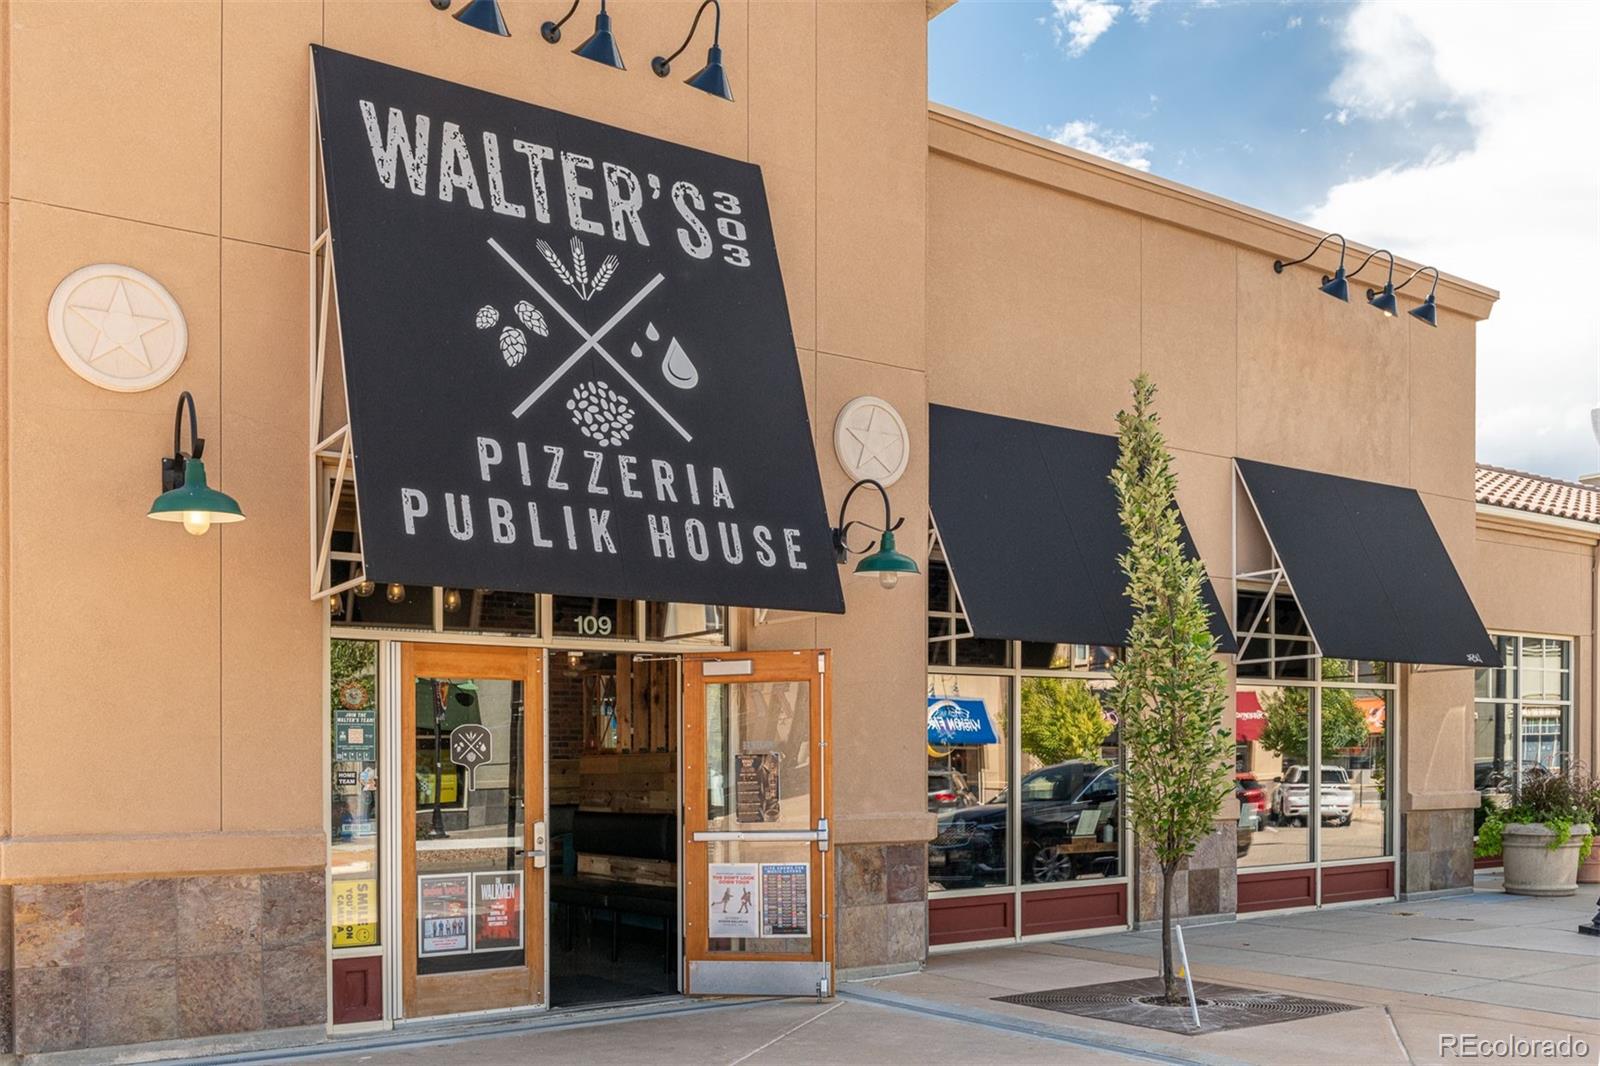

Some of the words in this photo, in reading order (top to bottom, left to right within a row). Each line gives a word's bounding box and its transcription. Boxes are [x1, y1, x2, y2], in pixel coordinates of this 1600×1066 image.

[359, 100, 714, 260] WALTER'S
[477, 436, 735, 510] PIZZERIA
[401, 488, 617, 554] PUBLIK
[648, 513, 808, 570] HOUSE
[573, 615, 612, 635] 109
[481, 883, 515, 901] WALKMEN
[346, 925, 354, 940] ON
